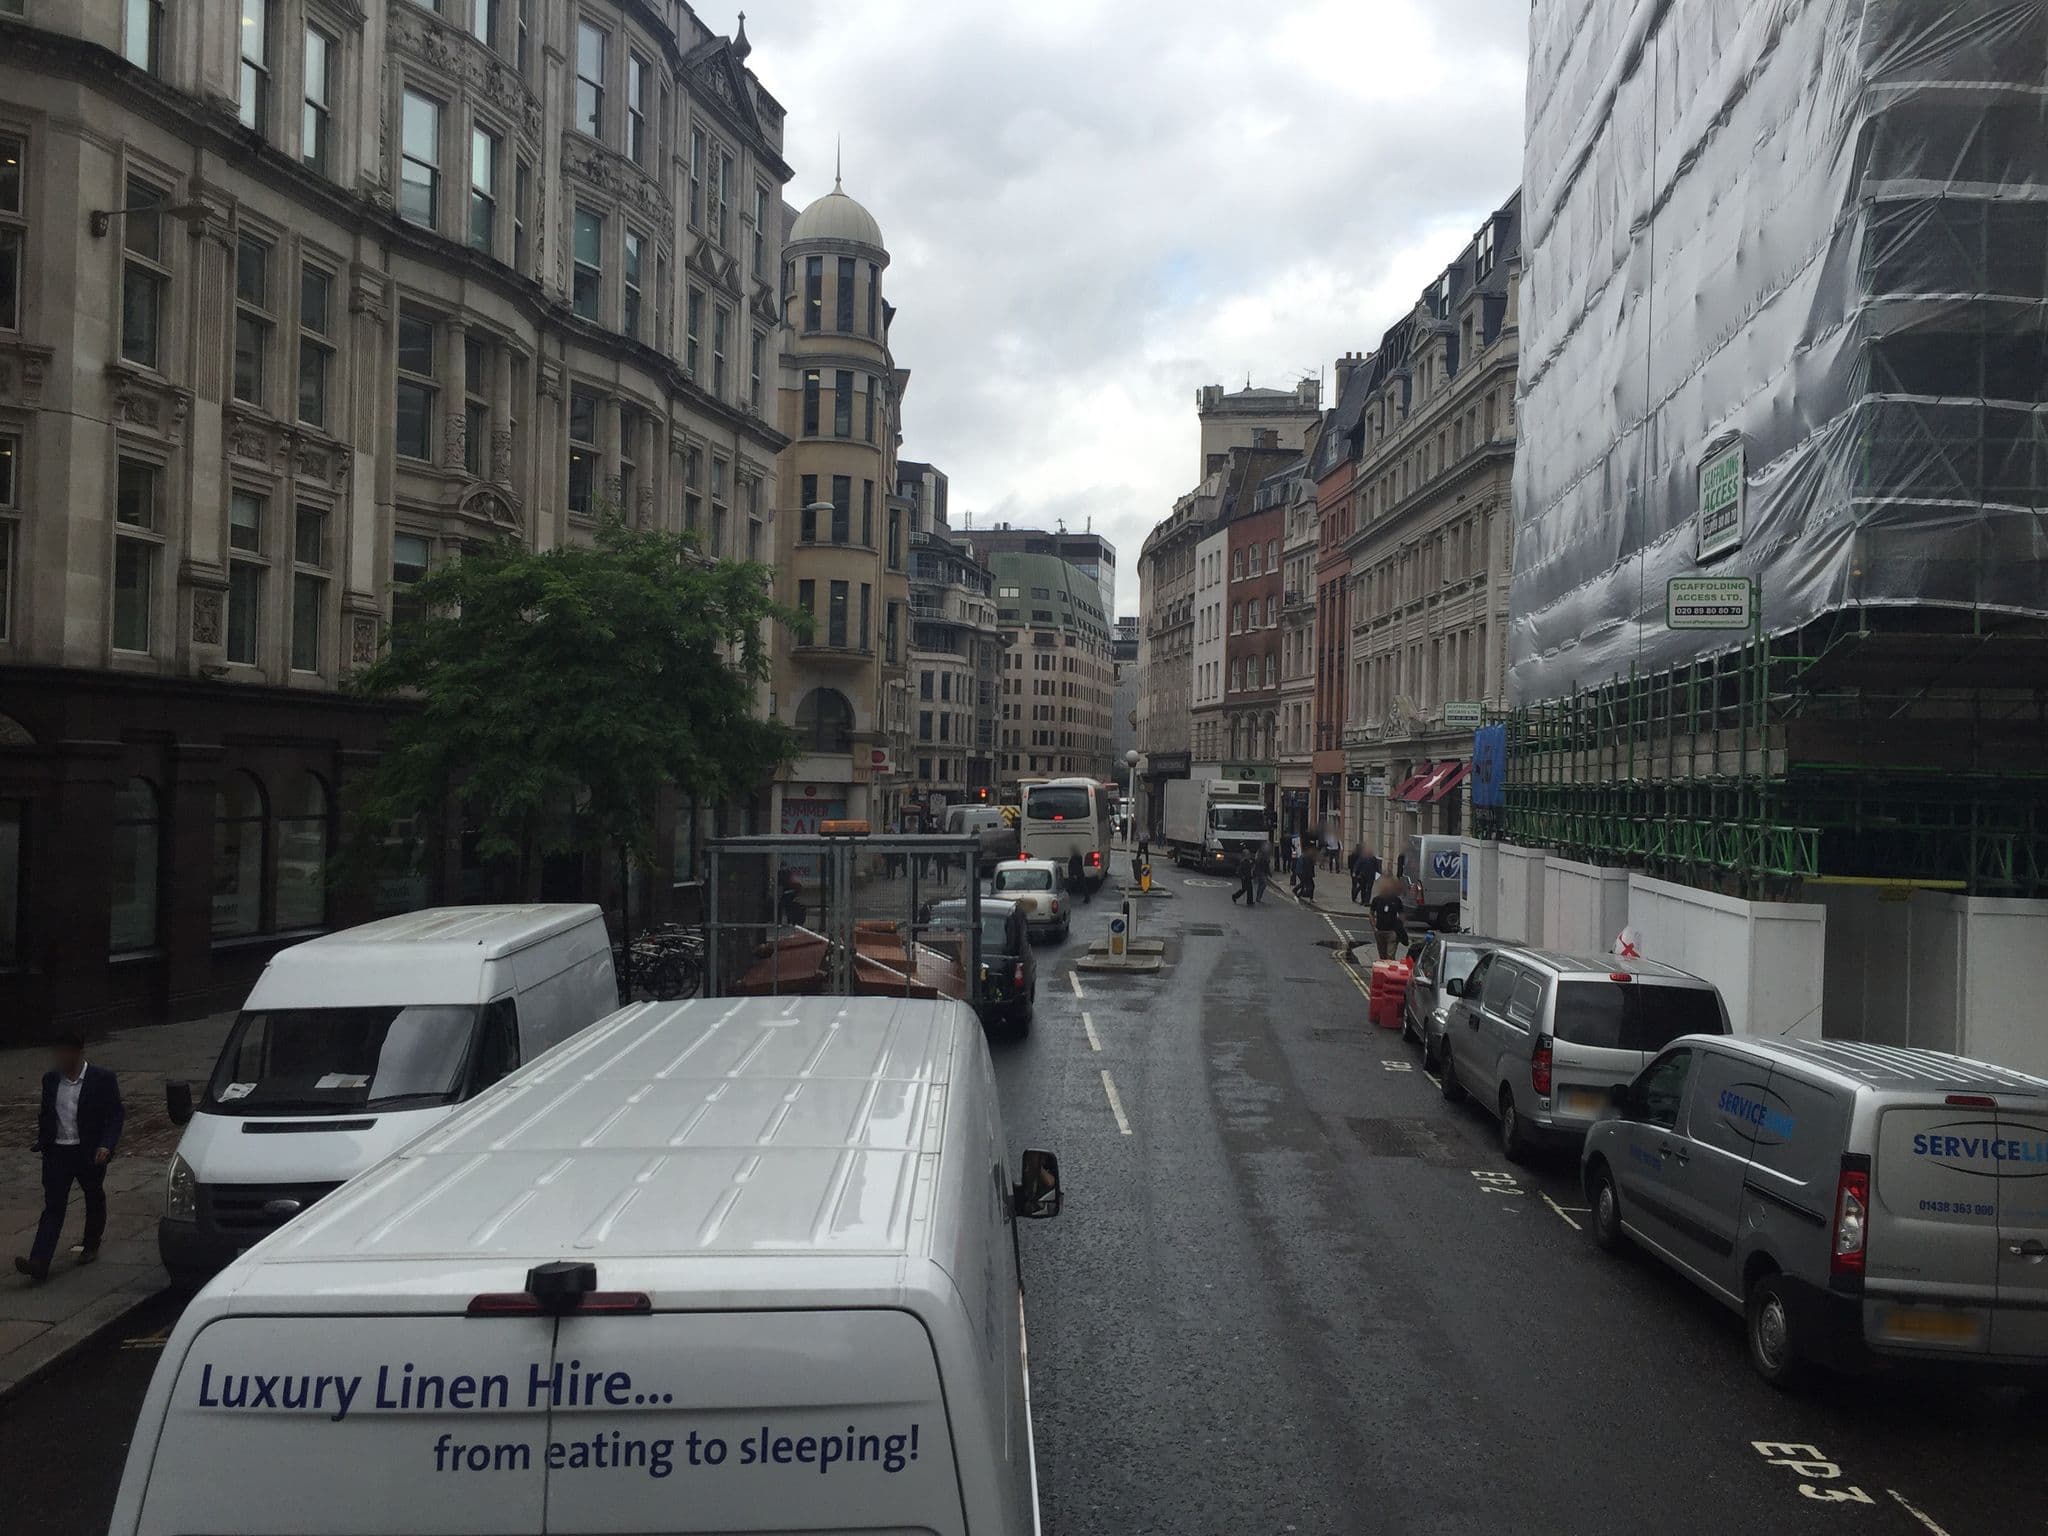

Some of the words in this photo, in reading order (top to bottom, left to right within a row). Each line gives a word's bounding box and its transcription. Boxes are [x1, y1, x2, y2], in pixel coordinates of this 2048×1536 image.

[1704, 474, 1738, 515] ACCESS
[1673, 583, 1745, 591] SCAFFOLDING
[1677, 593, 1717, 601] ACCESS
[1720, 593, 1743, 601] LTD.
[1676, 607, 1692, 615] 020
[1731, 607, 1741, 615] 70
[1919, 1199, 1950, 1213] 01438
[199, 1363, 362, 1423] Luxury
[375, 1362, 509, 1409] Linen
[527, 1359, 674, 1408] Hire...
[434, 1433, 530, 1473] from
[545, 1430, 675, 1478] eating
[686, 1430, 728, 1466] to
[740, 1423, 920, 1475] sleeping!
